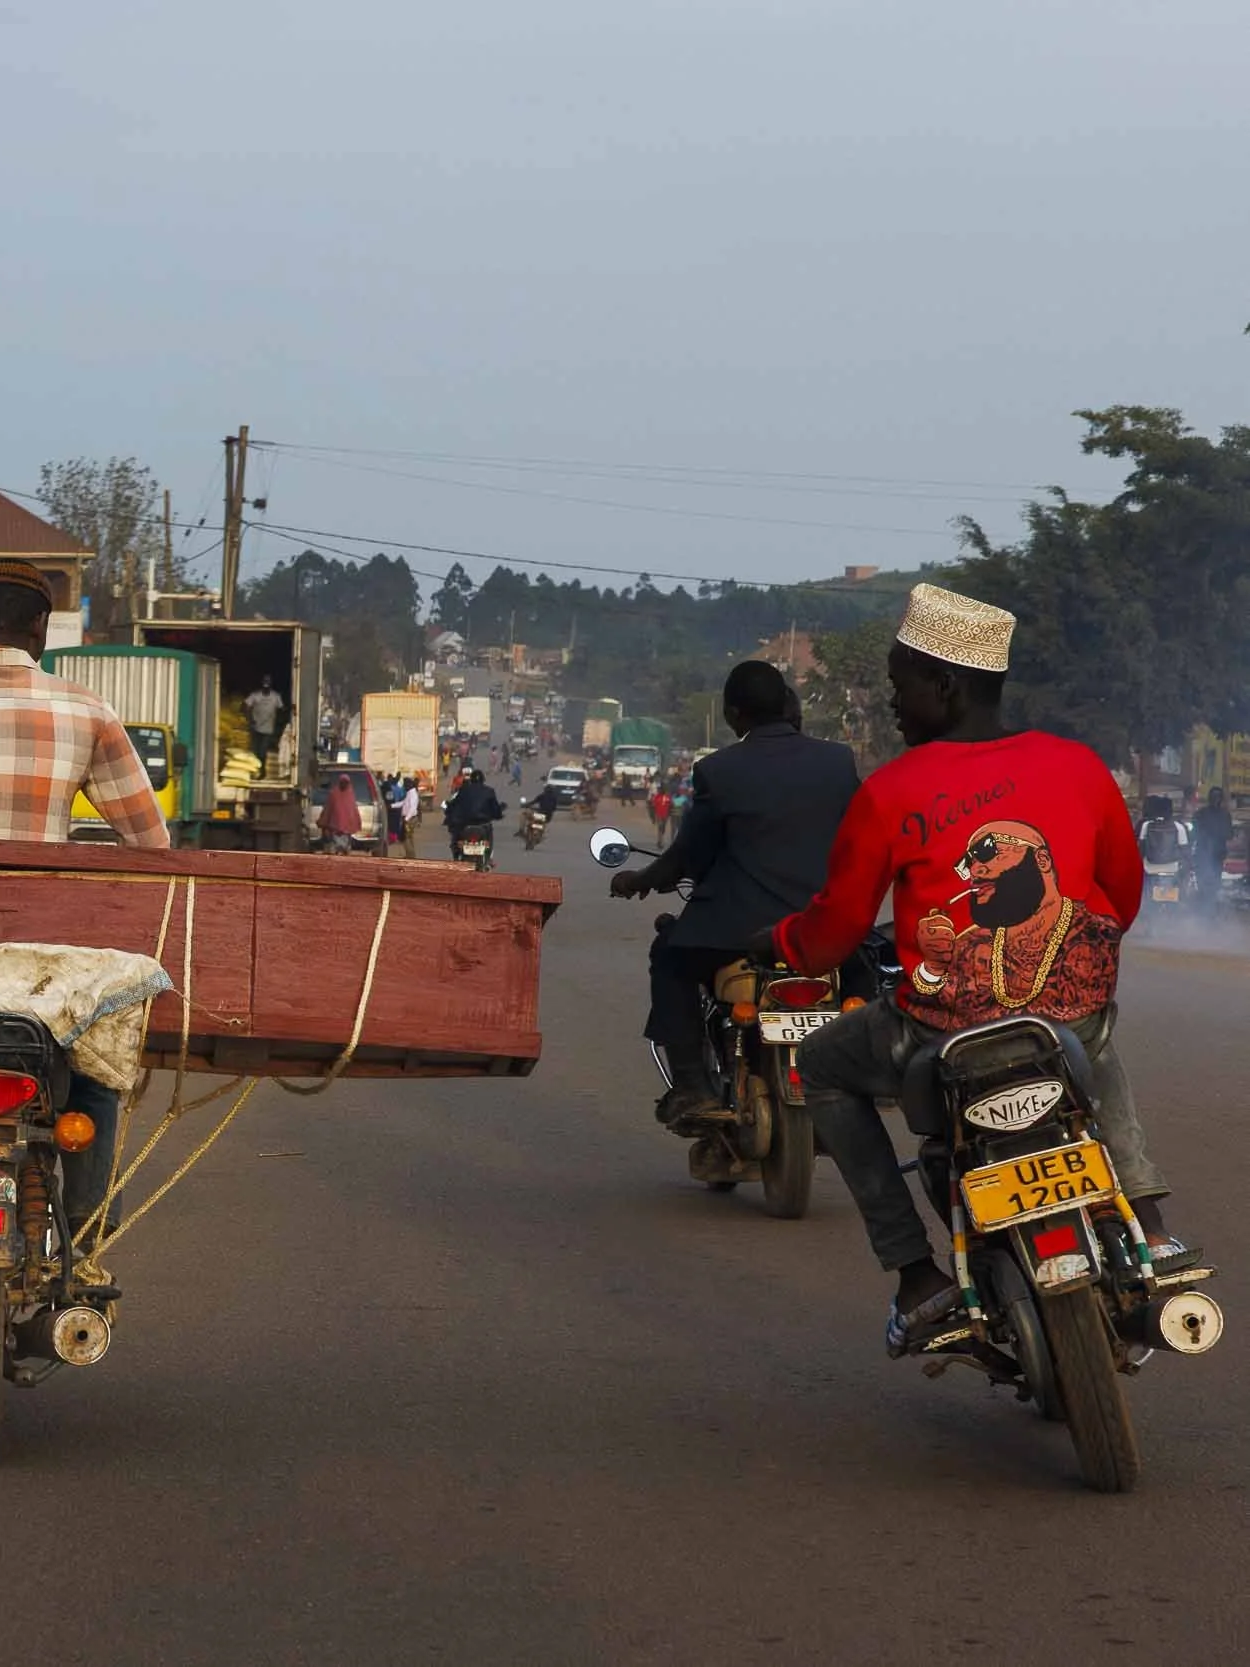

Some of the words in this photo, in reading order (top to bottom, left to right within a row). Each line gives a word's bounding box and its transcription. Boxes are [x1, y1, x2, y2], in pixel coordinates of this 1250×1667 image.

[989, 1094, 1041, 1126] NIKE
[1014, 1150, 1087, 1186] UEB
[1008, 1175, 1100, 1215] 120A
